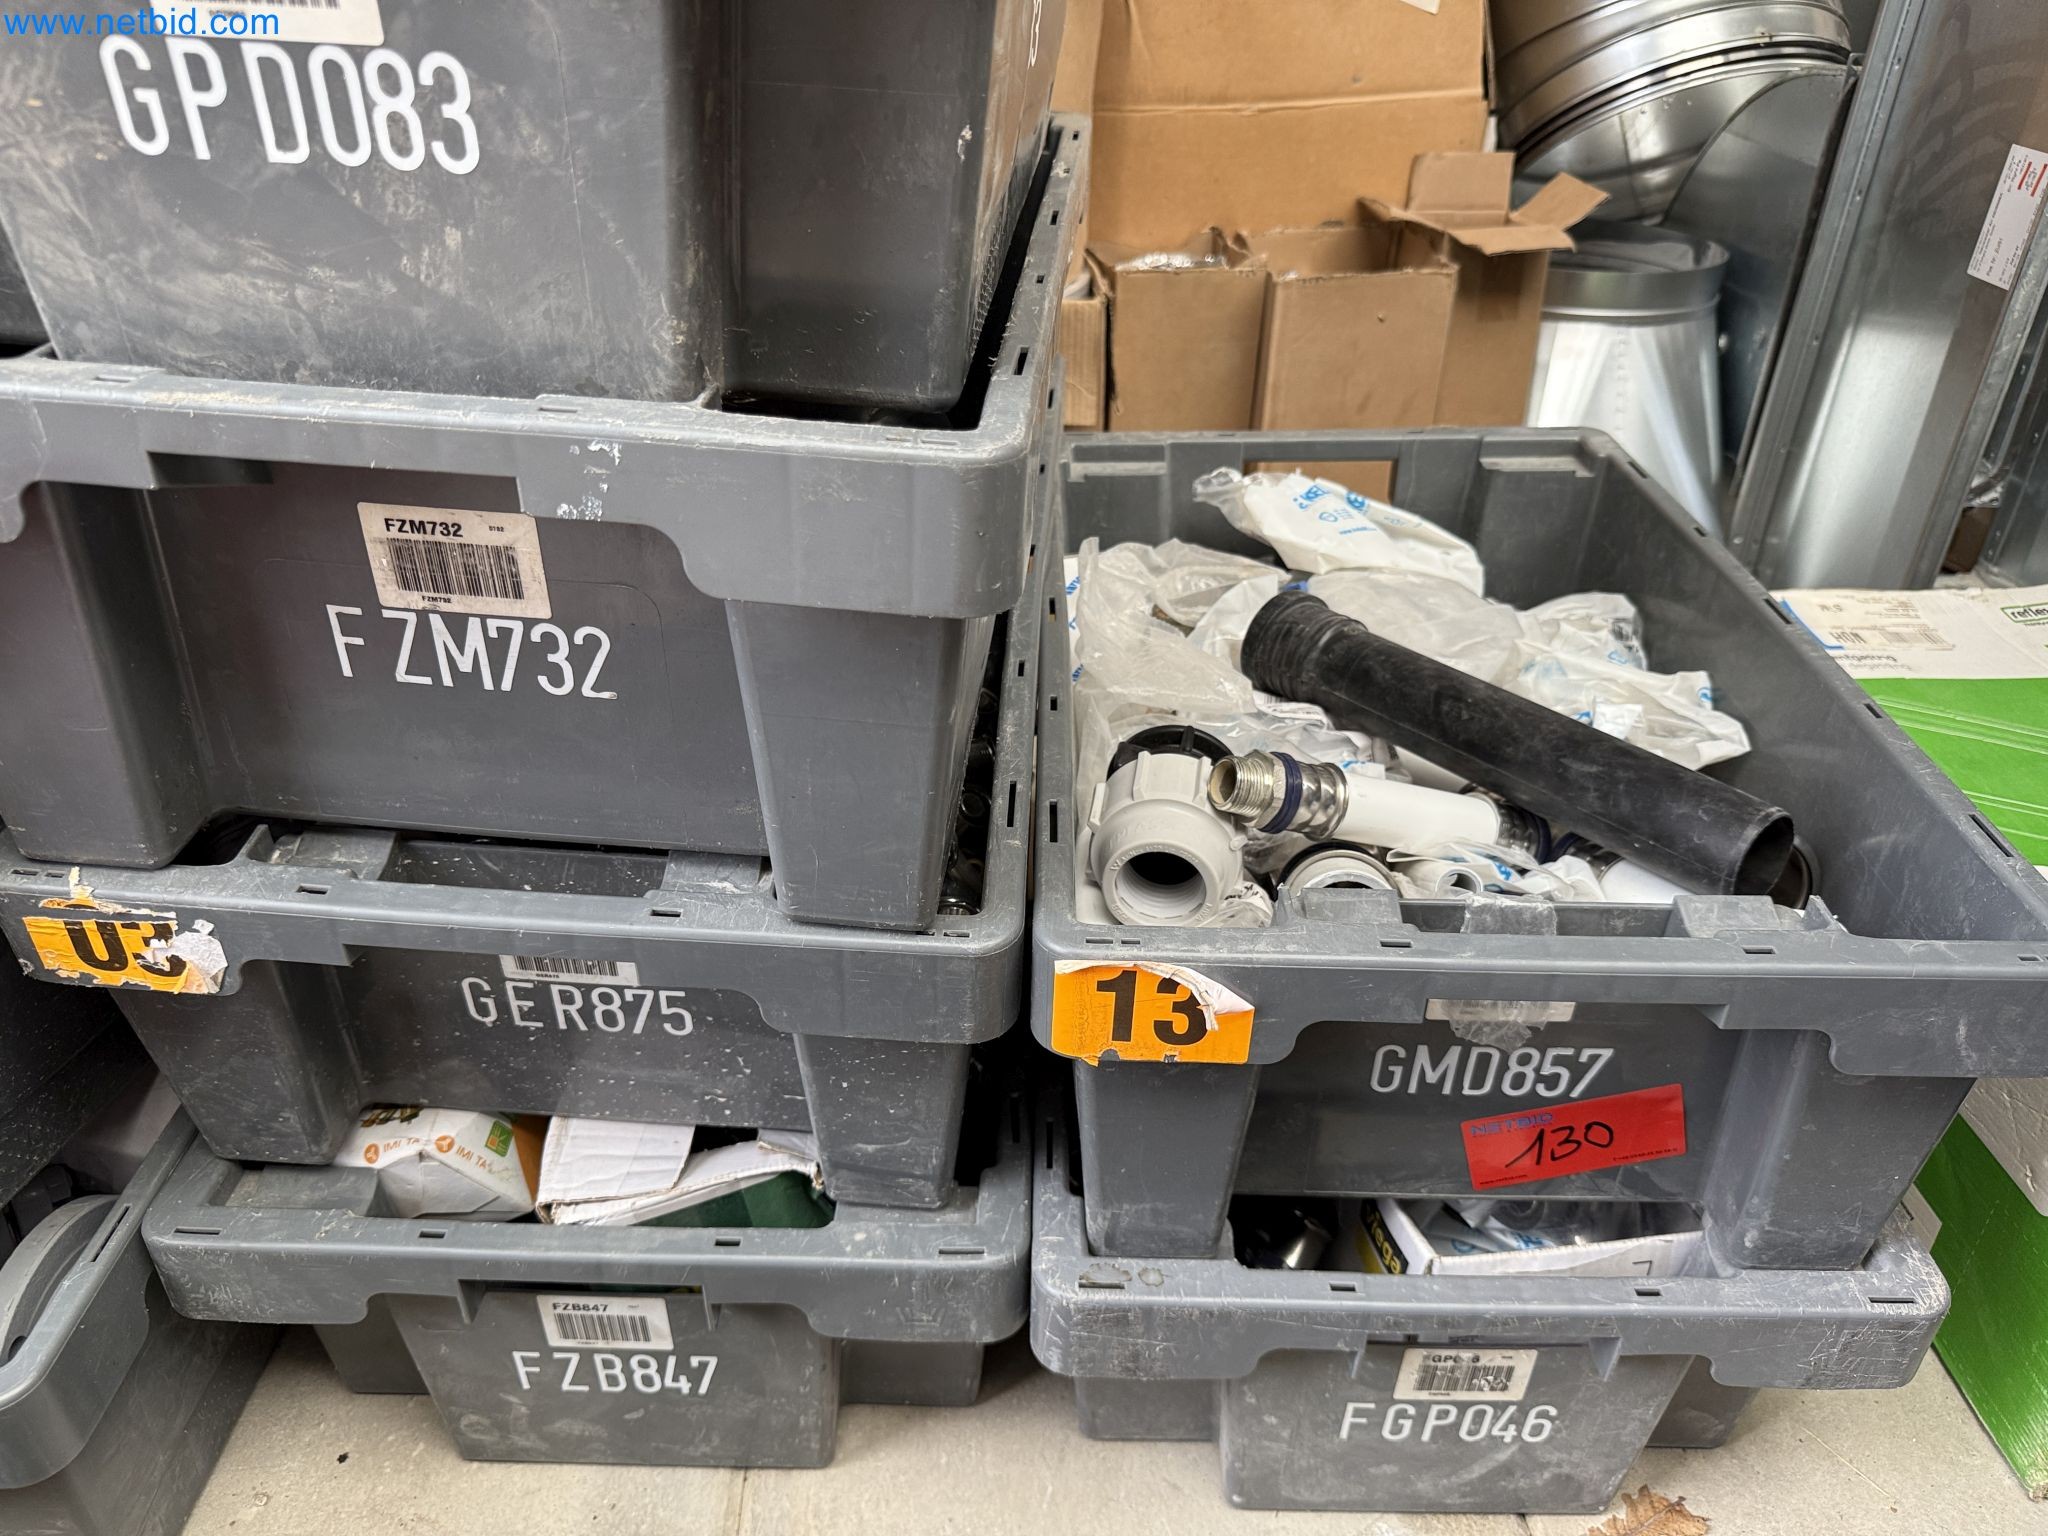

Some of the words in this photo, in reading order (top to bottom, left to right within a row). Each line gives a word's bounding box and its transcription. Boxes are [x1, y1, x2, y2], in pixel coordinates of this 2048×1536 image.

[99, 35, 480, 175] GPD083
[384, 517, 464, 538] FZM732
[325, 603, 619, 700] FZM732
[461, 976, 695, 1038] GER875
[1096, 967, 1209, 1047] 13
[383, 1139, 401, 1153] IMI
[455, 1145, 475, 1162] IMI
[1504, 1120, 1614, 1169] 130
[551, 1302, 609, 1312] FZB847
[511, 1349, 719, 1396] FZB847
[1338, 1401, 1560, 1445] FGP046
